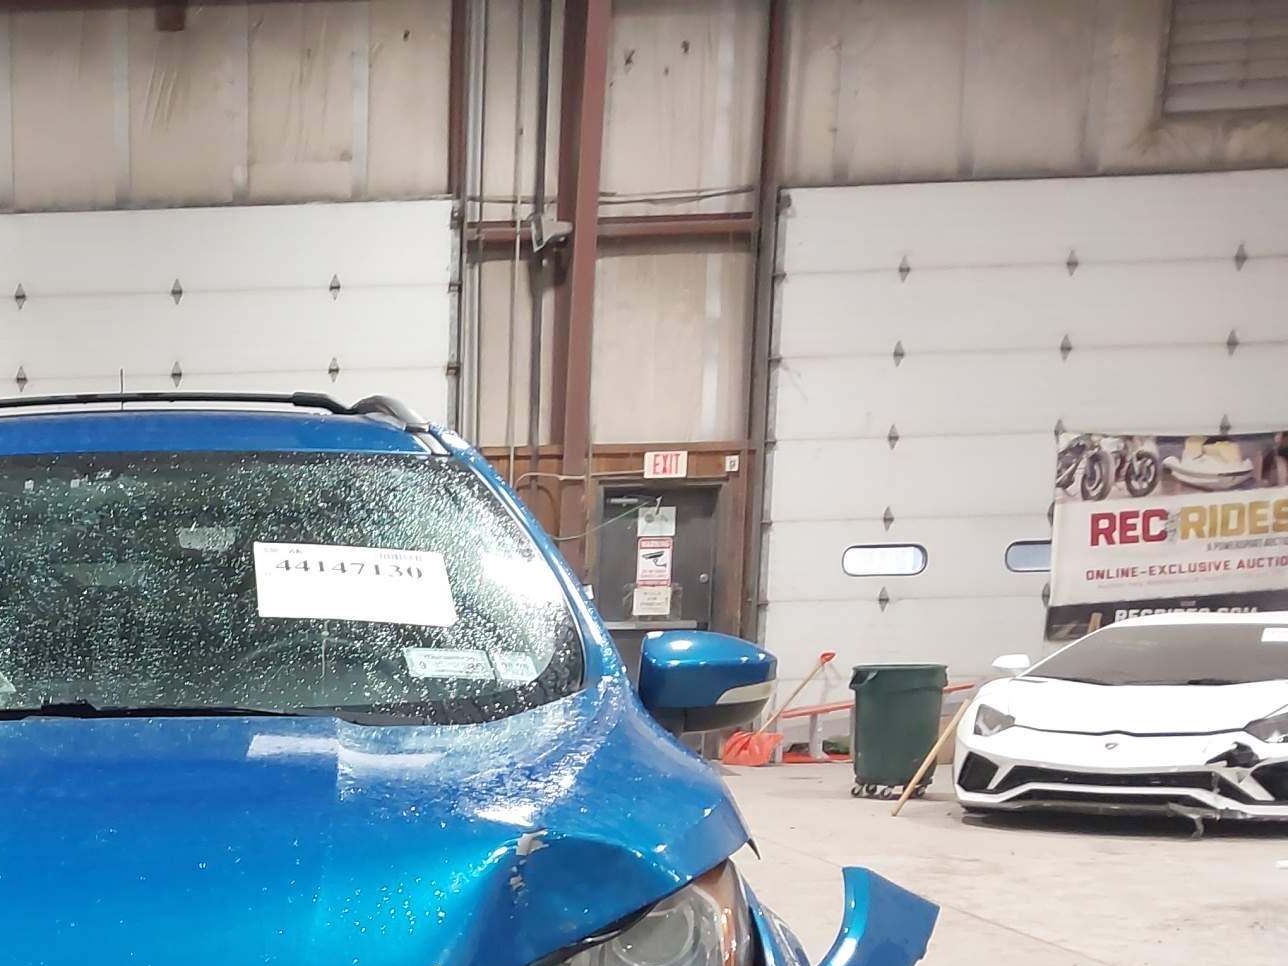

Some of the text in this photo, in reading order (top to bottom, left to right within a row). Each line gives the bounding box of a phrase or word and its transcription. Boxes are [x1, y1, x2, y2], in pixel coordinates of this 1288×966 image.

[652, 453, 681, 475] EXIT
[1090, 499, 1288, 546] REC RIDES
[275, 559, 423, 579] 44147130
[1086, 560, 1231, 581] ONLINE-EXCLUSIVE
